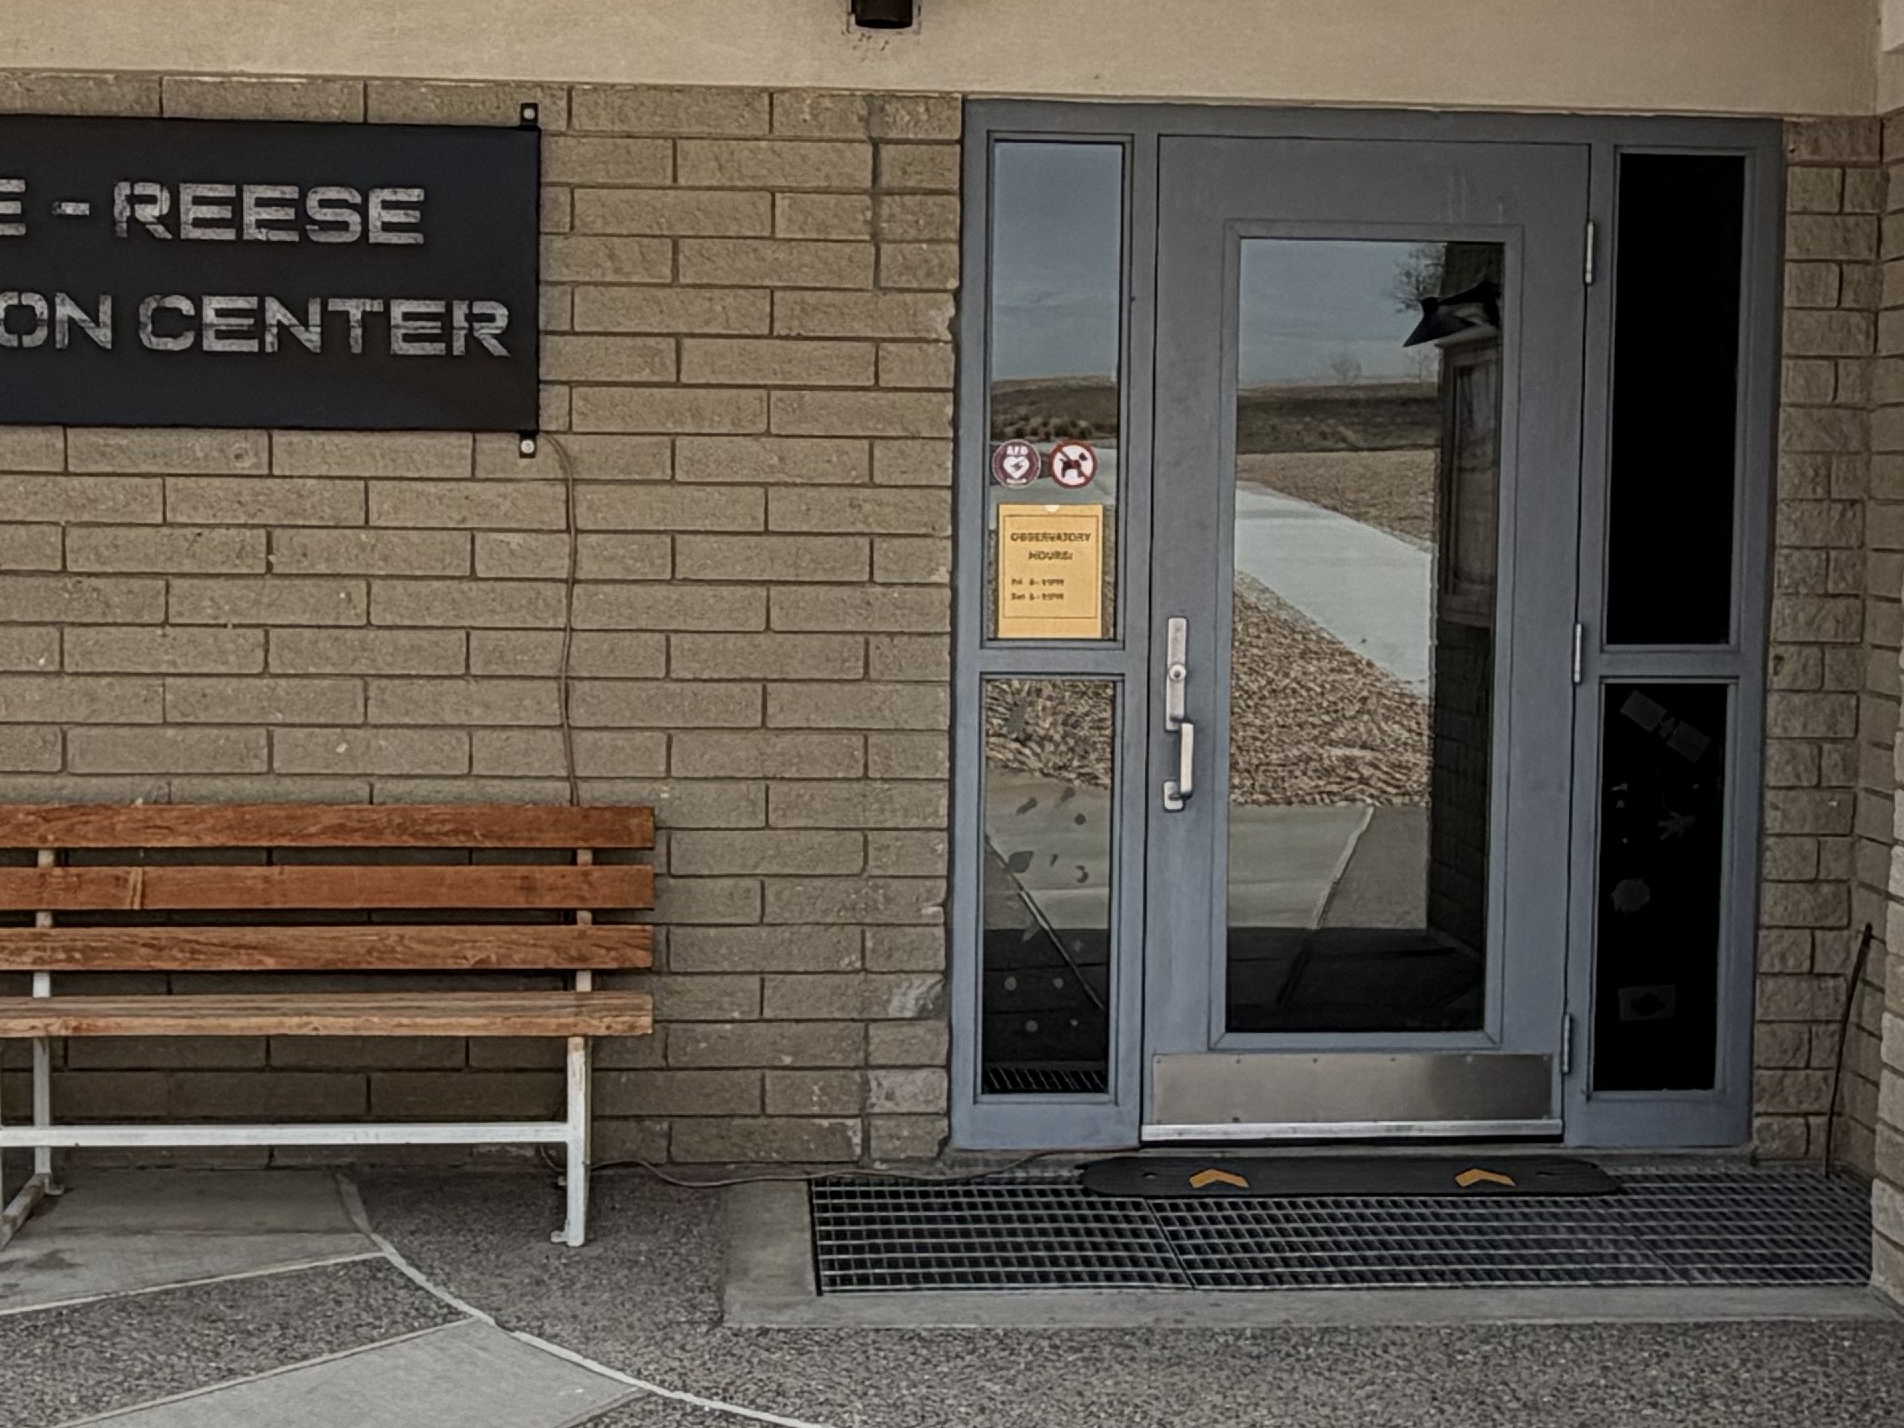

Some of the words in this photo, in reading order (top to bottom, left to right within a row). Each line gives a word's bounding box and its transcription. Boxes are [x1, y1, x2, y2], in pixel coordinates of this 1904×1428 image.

[114, 180, 428, 245] REESE
[138, 293, 513, 360] CENTER
[1006, 445, 1029, 456] AED
[1010, 532, 1092, 542] OBSERVATORY
